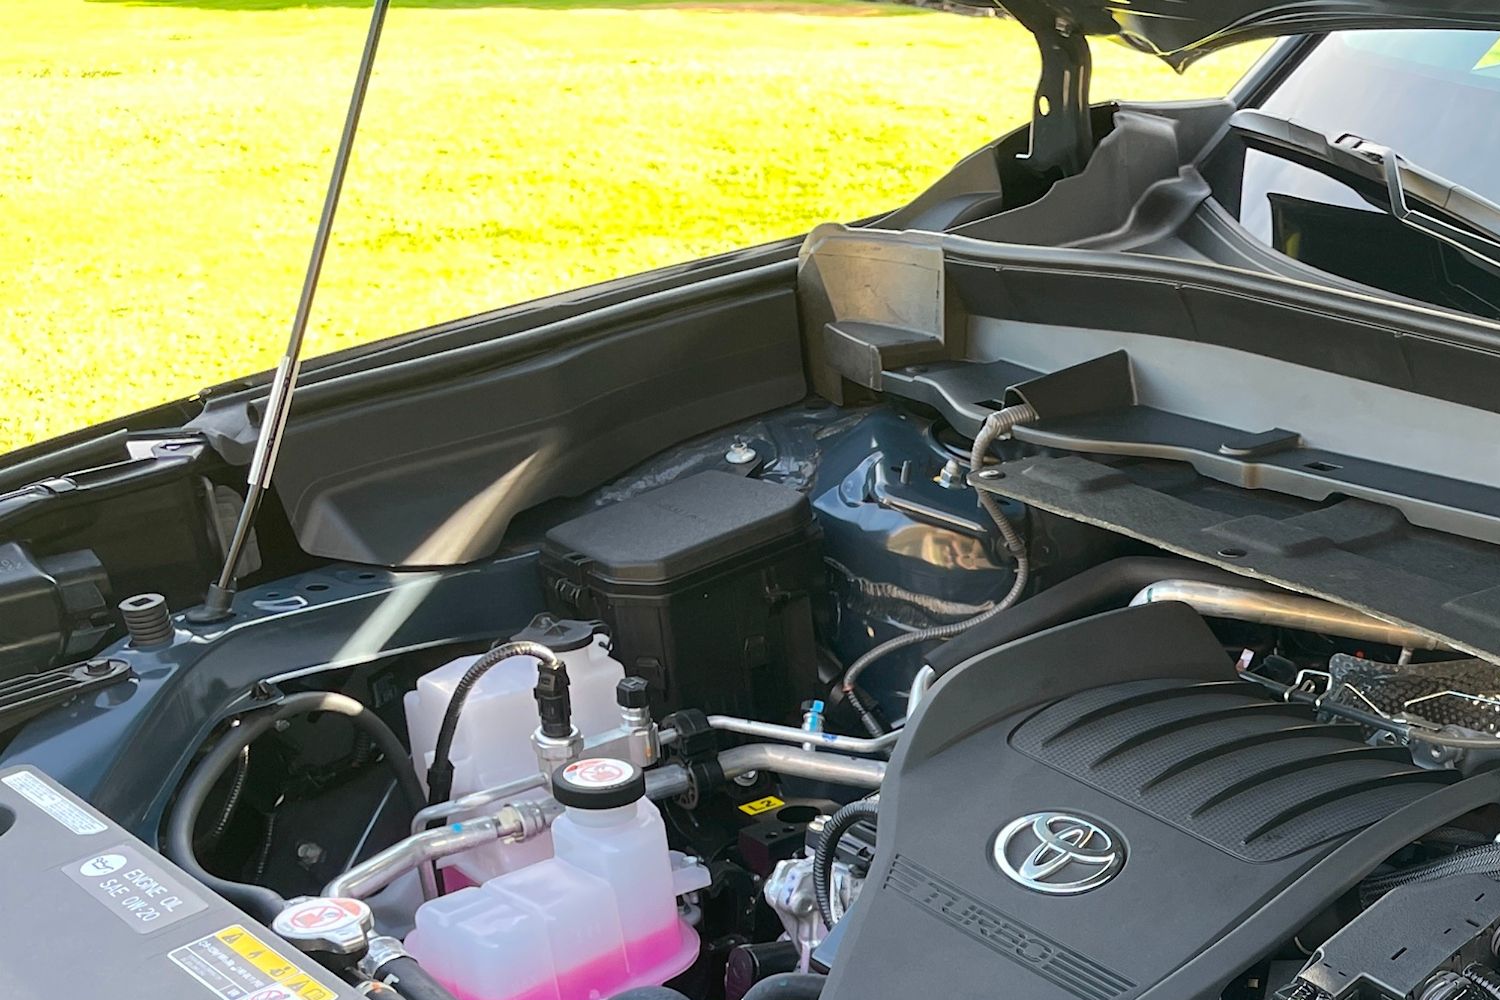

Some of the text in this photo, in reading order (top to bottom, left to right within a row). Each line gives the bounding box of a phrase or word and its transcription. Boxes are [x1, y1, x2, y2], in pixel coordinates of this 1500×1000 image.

[747, 800, 777, 811] L2
[99, 878, 161, 921] SAE 0W-20
[123, 868, 183, 912] ENGINE OIL
[924, 882, 1053, 963] TURBO
